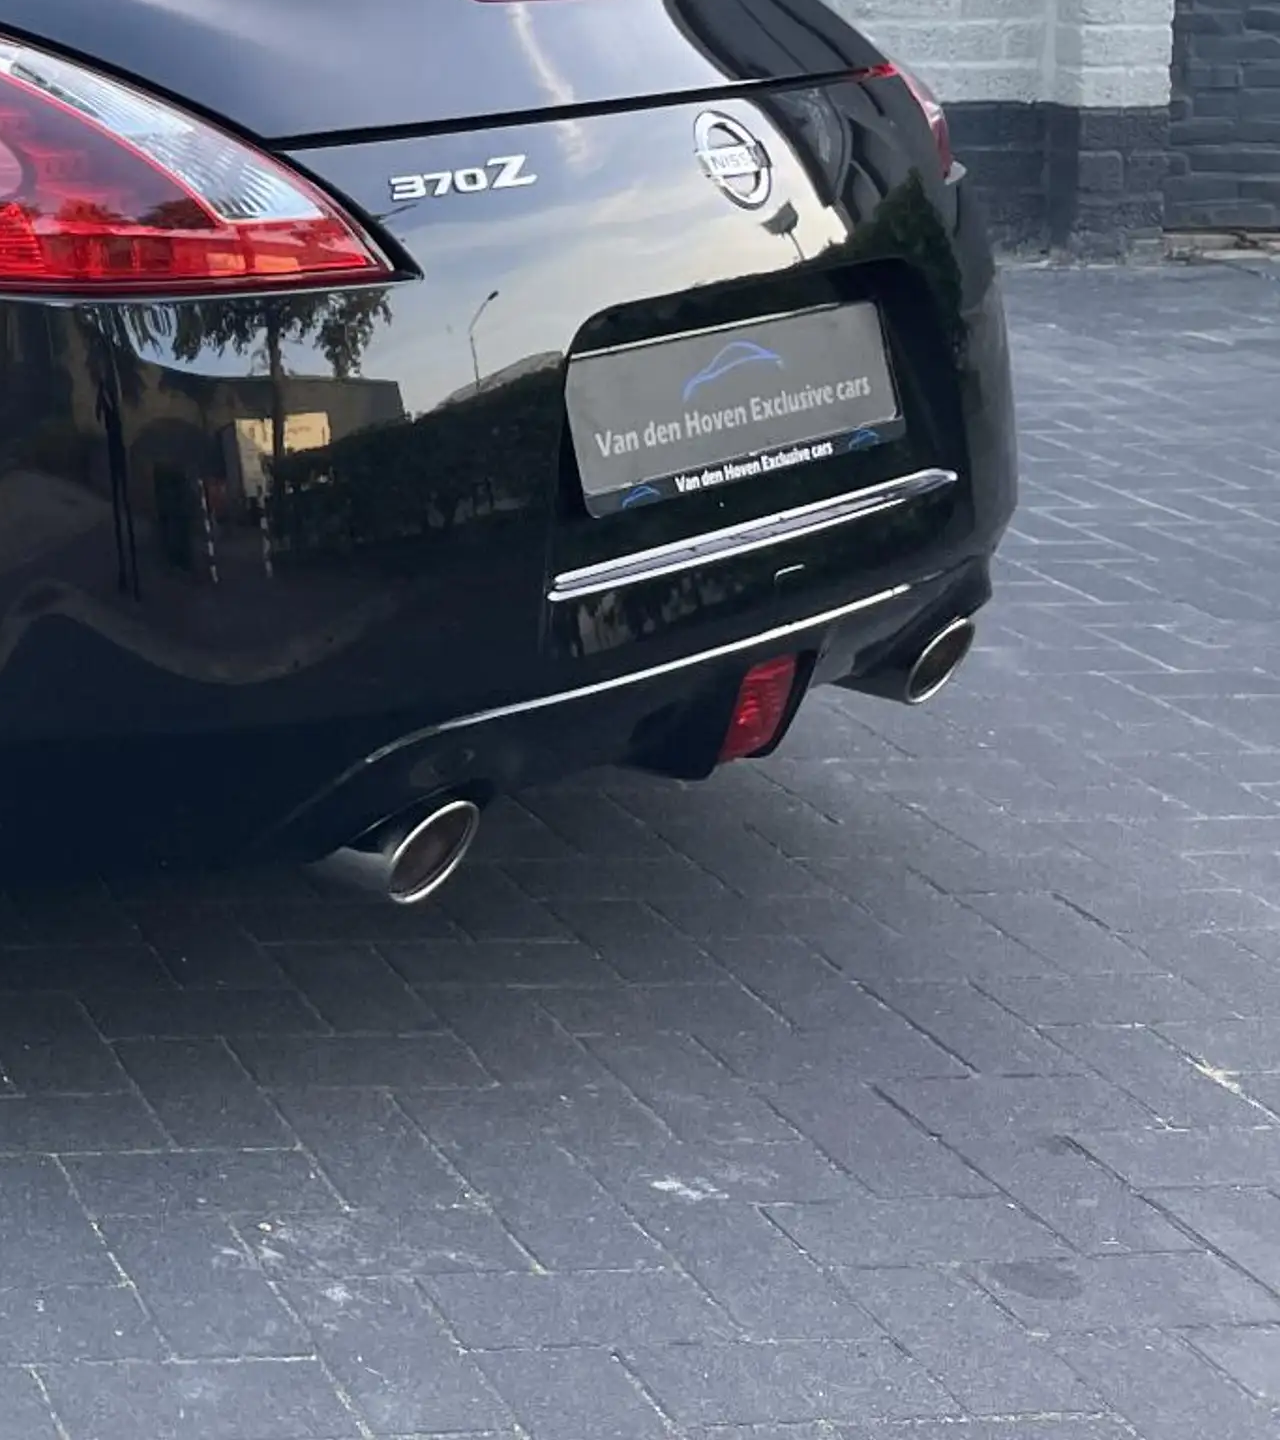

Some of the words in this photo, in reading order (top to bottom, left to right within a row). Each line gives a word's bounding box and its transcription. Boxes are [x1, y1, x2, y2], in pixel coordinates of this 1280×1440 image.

[388, 153, 538, 202] 370Z
[595, 428, 640, 458] Van
[643, 418, 682, 448] den
[684, 404, 747, 438] Hoven
[750, 384, 834, 422] Exclusive
[836, 375, 871, 402] cars
[674, 473, 699, 493] Van
[701, 467, 723, 486] den
[724, 458, 761, 480] Hoven
[762, 446, 811, 472] Exclusive
[812, 441, 834, 460] cars
